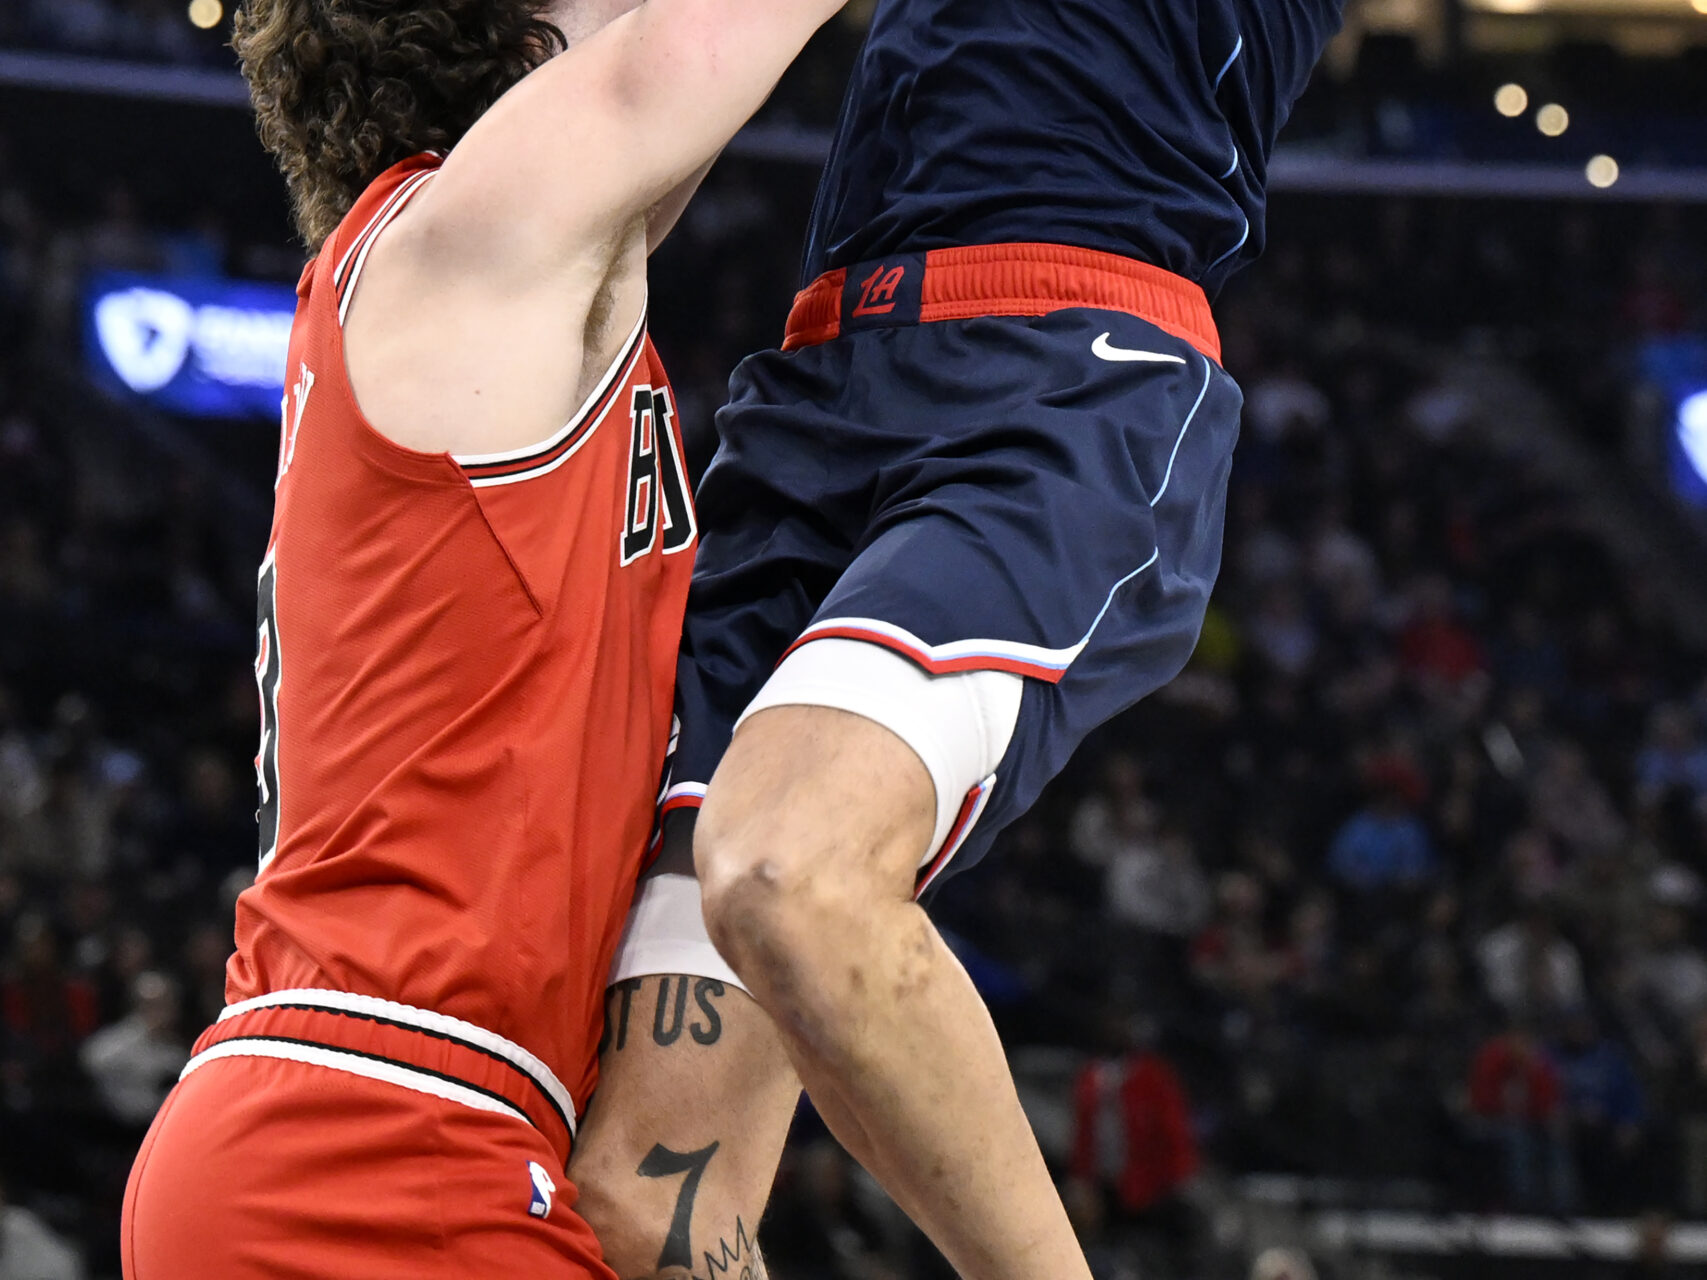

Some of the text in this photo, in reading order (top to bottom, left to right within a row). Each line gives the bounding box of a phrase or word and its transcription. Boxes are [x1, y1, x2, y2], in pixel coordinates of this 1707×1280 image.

[852, 264, 905, 318] LA
[653, 974, 726, 1048] US
[636, 1140, 721, 1273] 7
